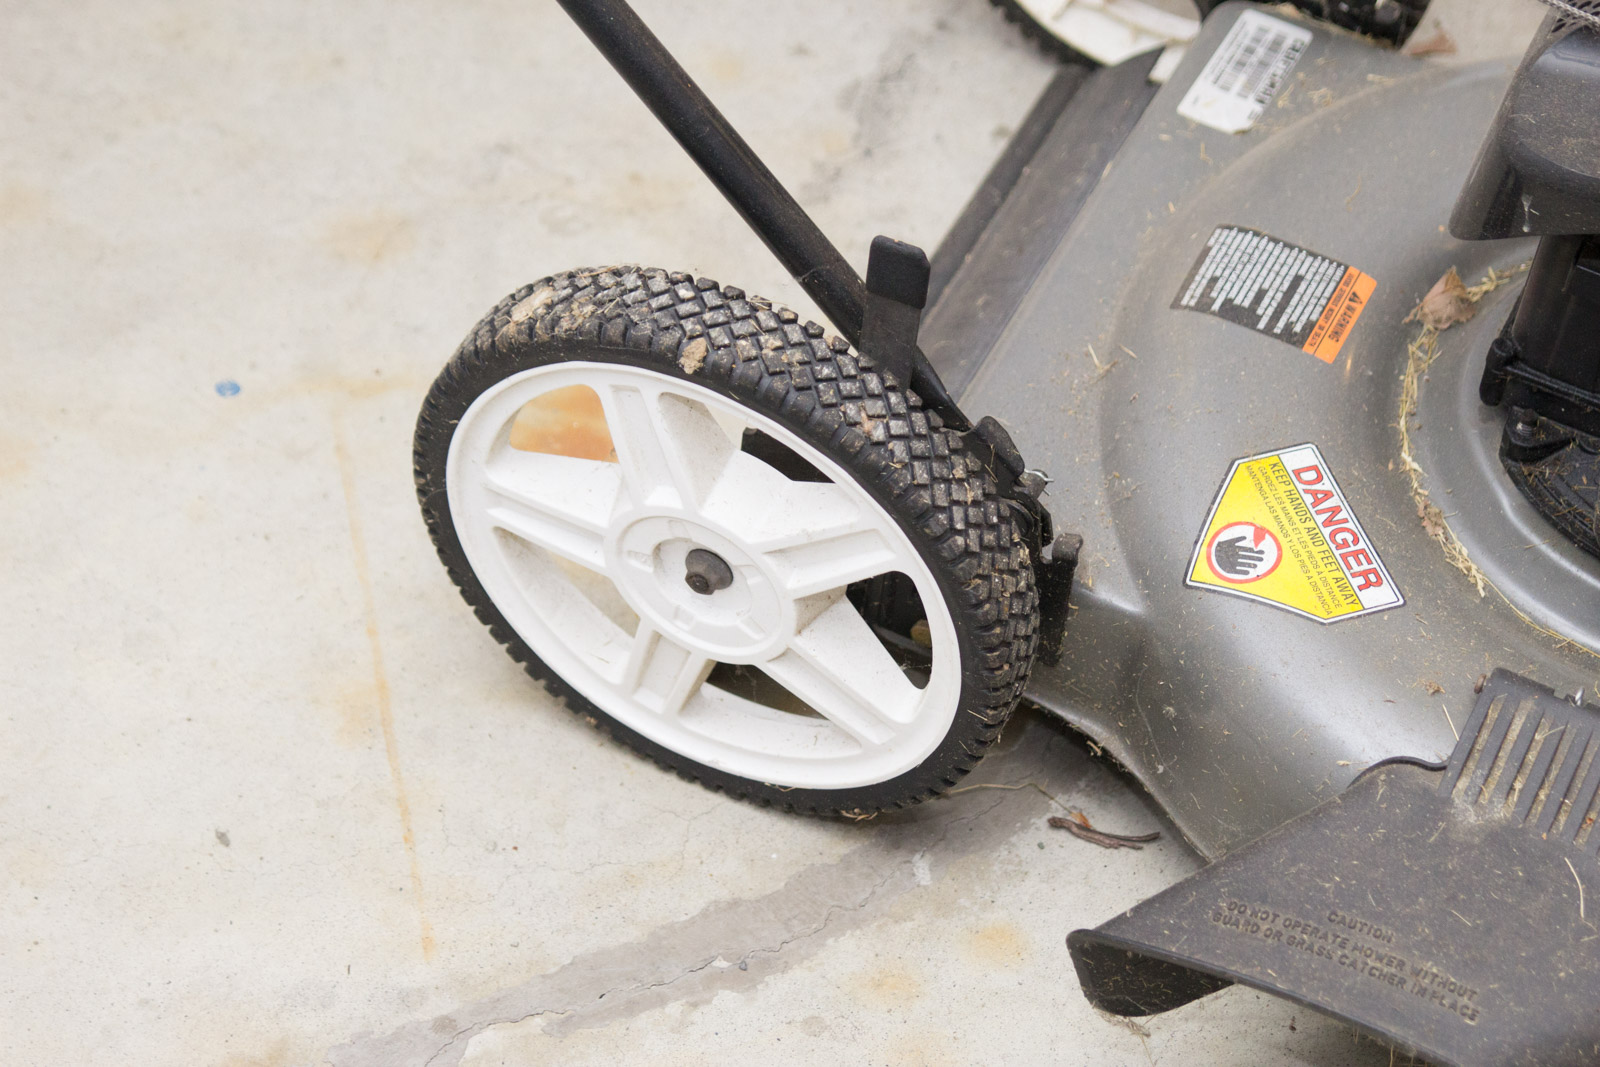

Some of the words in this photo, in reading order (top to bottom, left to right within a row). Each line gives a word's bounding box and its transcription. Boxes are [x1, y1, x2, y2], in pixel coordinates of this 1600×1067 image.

[1328, 303, 1357, 342] WARNING
[1246, 465, 1269, 500] MANTENGA
[1265, 501, 1277, 514] LAS
[1273, 514, 1290, 538] MANOS
[1289, 544, 1301, 558] LOS
[1297, 559, 1310, 574] PIES
[1309, 581, 1333, 615] DISTANCIA
[1258, 466, 1278, 492] GARDEZ
[1273, 492, 1285, 506] LES
[1280, 506, 1296, 526] MAINS
[1292, 527, 1302, 535] ET
[1297, 536, 1309, 549] LES
[1305, 550, 1320, 570] PIEDS
[1320, 576, 1342, 609] DISTANCE
[1269, 462, 1290, 486] KEEP
[1284, 489, 1311, 523] HANDS
[1304, 527, 1324, 547] AND
[1318, 549, 1340, 573] FEET
[1332, 576, 1359, 605] AWAY
[1292, 464, 1382, 592] DANGER
[1212, 912, 1260, 934] GUARD
[1263, 927, 1283, 941] OR
[1286, 935, 1333, 960] GRASS
[1338, 954, 1406, 989] CATCHER
[1410, 982, 1427, 998] IN
[1430, 990, 1480, 1021] PLACE
[1227, 901, 1248, 914] DO
[1250, 906, 1280, 924] NOT
[1282, 918, 1350, 949] OPERATE
[1352, 942, 1406, 971] MOWER
[1410, 964, 1478, 1001] WITHOUT
[1327, 910, 1394, 944] CAUTION
